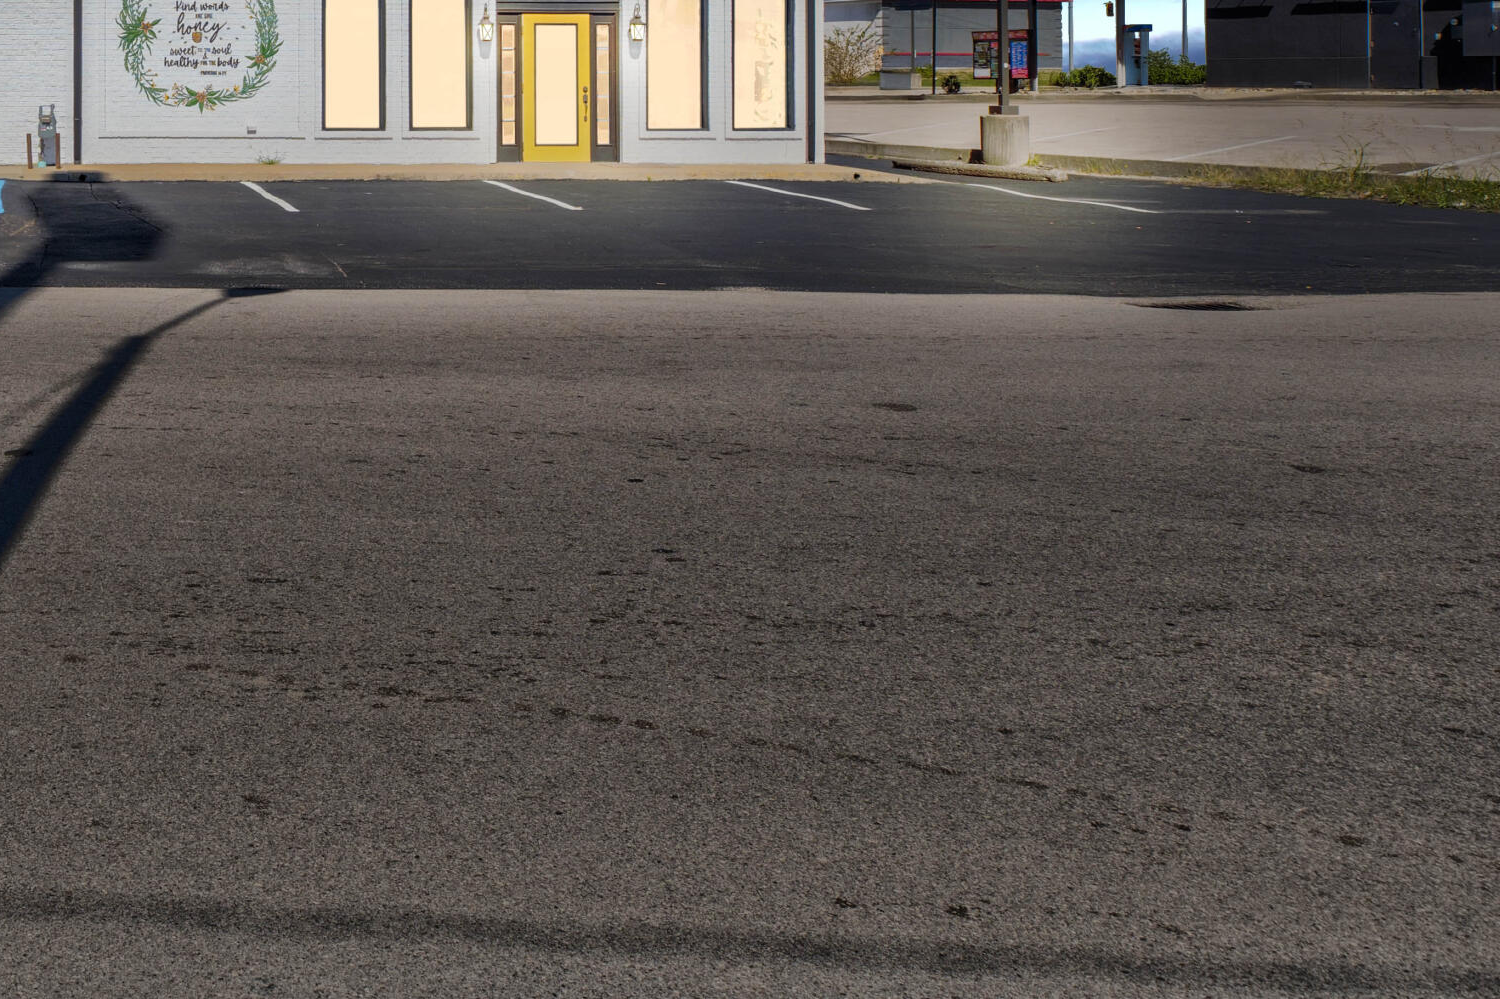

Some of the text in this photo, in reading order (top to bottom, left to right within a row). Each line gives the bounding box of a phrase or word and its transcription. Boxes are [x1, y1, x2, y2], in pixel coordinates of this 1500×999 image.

[174, 0, 230, 12] Kind words
[176, 11, 227, 43] honey
[169, 45, 197, 56] sweet
[211, 43, 232, 55] soul
[164, 56, 199, 69] healthy
[217, 56, 240, 69] body
